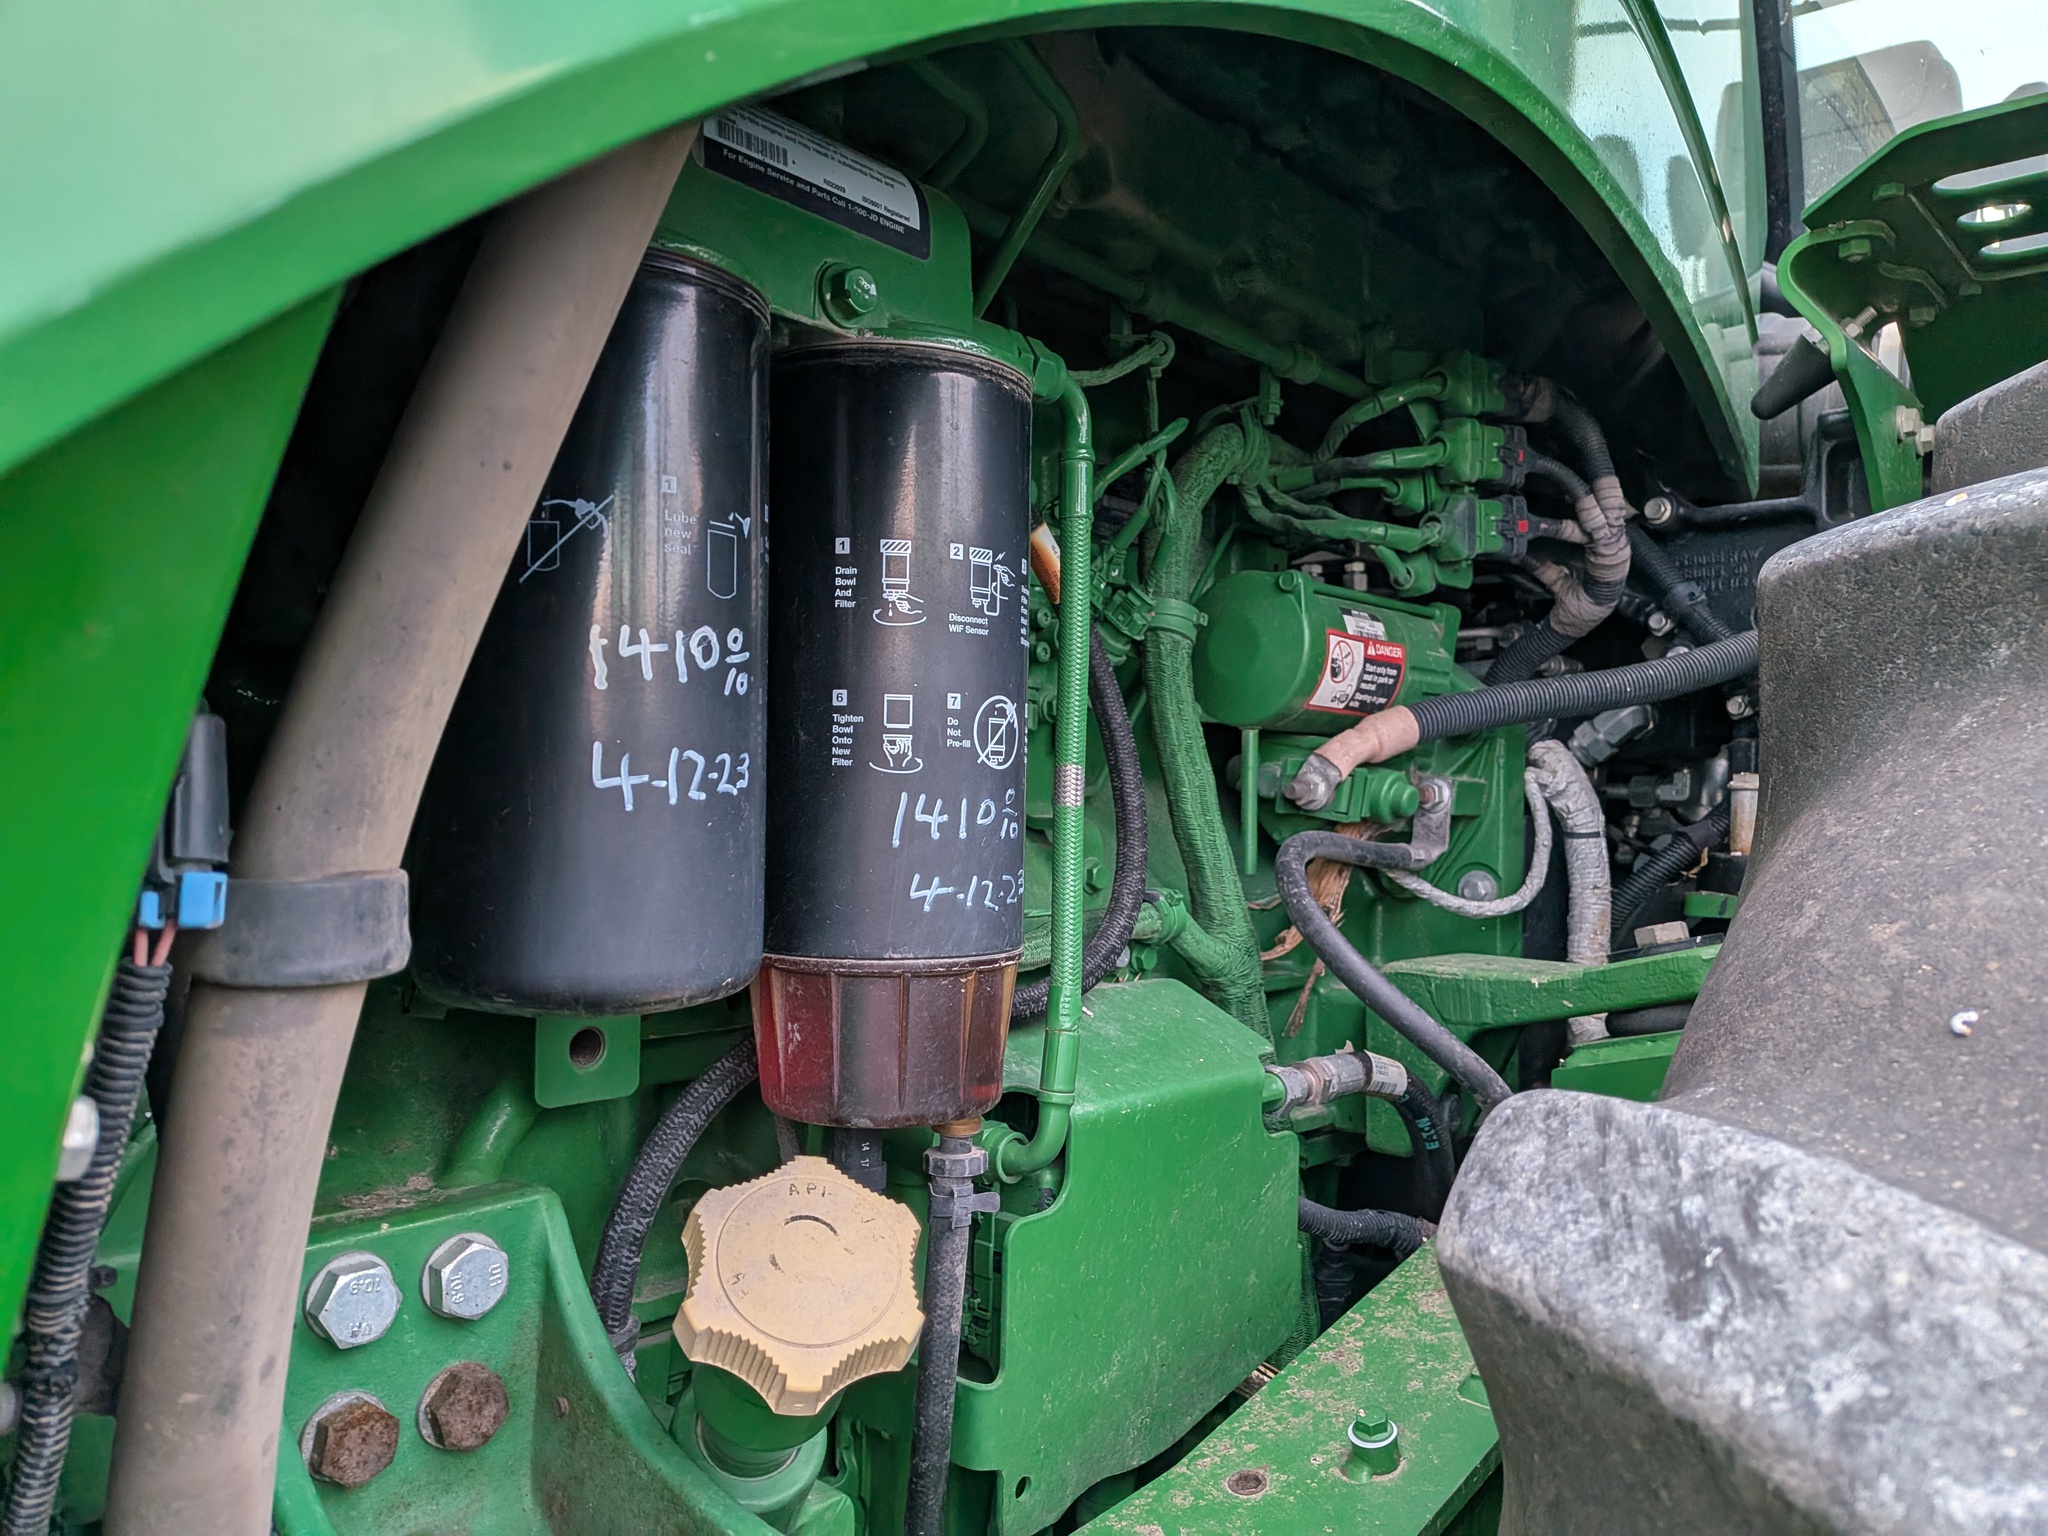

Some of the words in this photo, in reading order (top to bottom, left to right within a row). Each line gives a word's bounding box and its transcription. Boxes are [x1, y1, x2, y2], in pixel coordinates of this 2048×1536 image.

[723, 148, 737, 160] For
[738, 155, 766, 173] Engine
[767, 167, 795, 185] Service
[796, 181, 810, 193] and
[812, 188, 831, 201] Parts
[832, 195, 846, 208] Call
[880, 217, 905, 234] ENGINE
[884, 205, 911, 222] Registered
[664, 510, 697, 525] Lube
[664, 528, 692, 540] new
[664, 543, 692, 556] seal
[835, 566, 858, 575] Drain
[835, 577, 856, 586] Bowl
[835, 588, 852, 597] And
[835, 599, 856, 608] Filter
[949, 613, 989, 626] Disconnect
[949, 624, 964, 634] WIF
[965, 625, 989, 636] Sensor
[1376, 644, 1403, 659] DANGER
[1365, 662, 1377, 673] Start
[1376, 666, 1386, 676] only
[1386, 667, 1398, 676] from
[1377, 676, 1388, 685] park
[832, 714, 864, 724] Tighten
[947, 717, 959, 726] Do
[832, 725, 854, 734] Bowl
[947, 728, 962, 737] Not
[832, 736, 853, 745] Onto
[947, 739, 971, 748] Pre-fill
[832, 747, 851, 756] New
[832, 758, 853, 767] Filter
[861, 1141, 870, 1151] 14
[860, 1158, 870, 1167] 17
[349, 1276, 382, 1296] 10.9
[450, 1271, 465, 1305] 10.9
